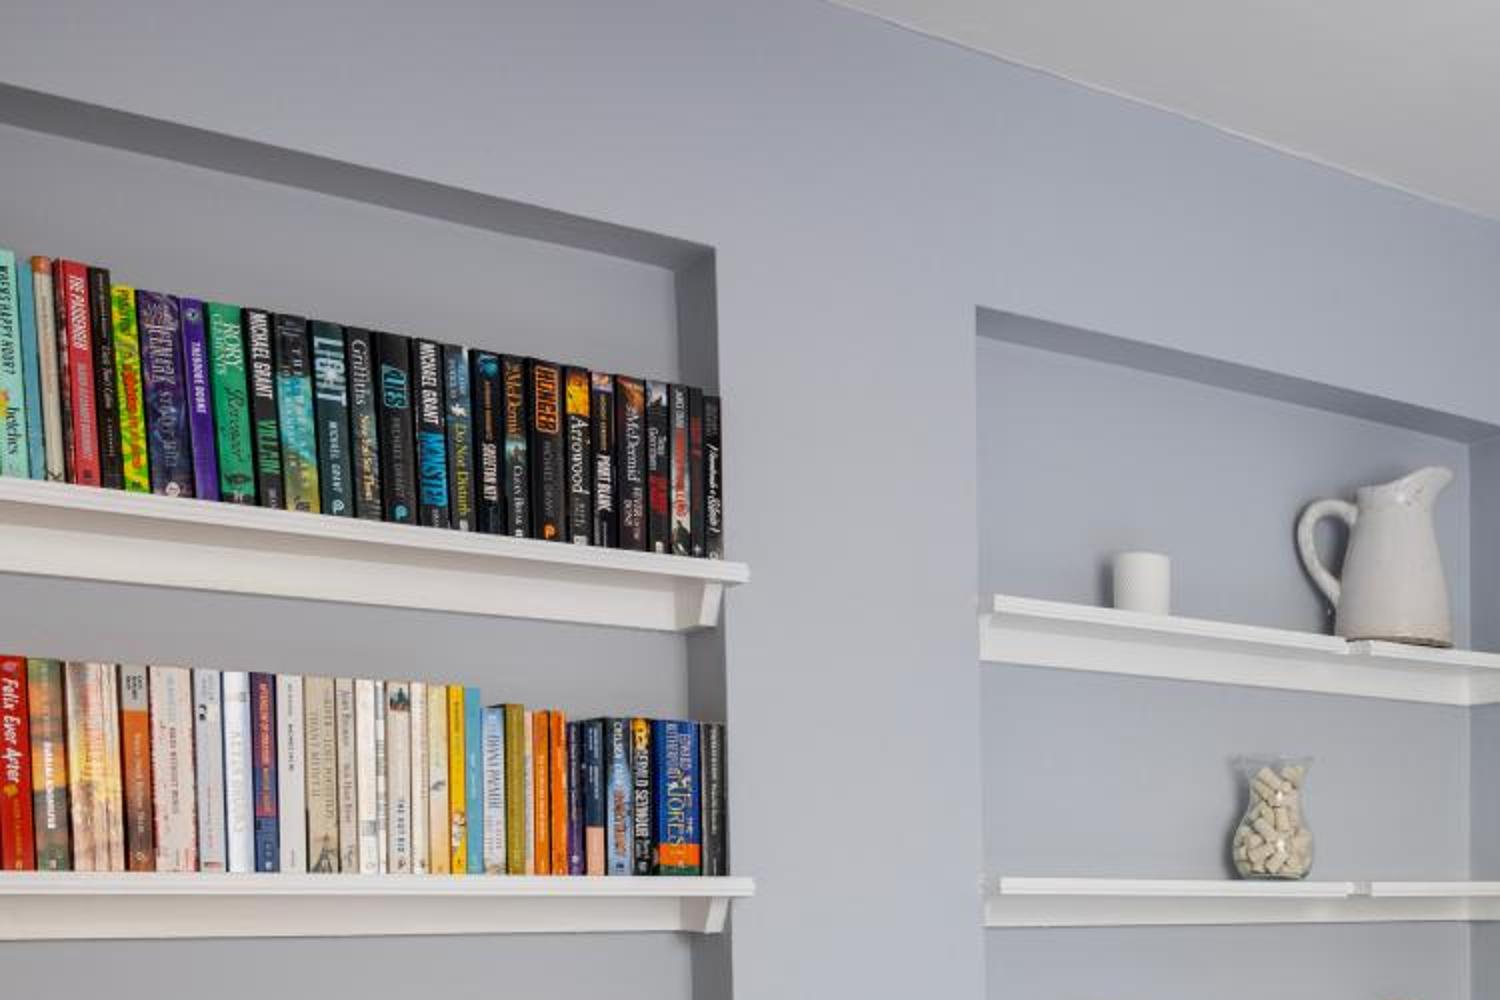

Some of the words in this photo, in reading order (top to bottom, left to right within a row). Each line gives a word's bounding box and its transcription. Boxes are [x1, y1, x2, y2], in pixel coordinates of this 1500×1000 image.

[0, 305, 12, 339] HAPPY
[249, 311, 268, 360] MICHAEL
[223, 322, 243, 371] RORY
[419, 342, 437, 388] MICHAEL
[253, 362, 274, 400] GRANT
[313, 336, 347, 407] LIGHT
[351, 339, 370, 405] Griffiths
[422, 389, 440, 425] GRANT
[418, 431, 448, 507] MONSTER
[456, 443, 467, 467] Not
[571, 416, 590, 495] Arrowood
[2, 678, 19, 710] Felix
[3, 715, 21, 744] Ever
[2, 747, 22, 783] After
[635, 789, 649, 837] SEYMOUR
